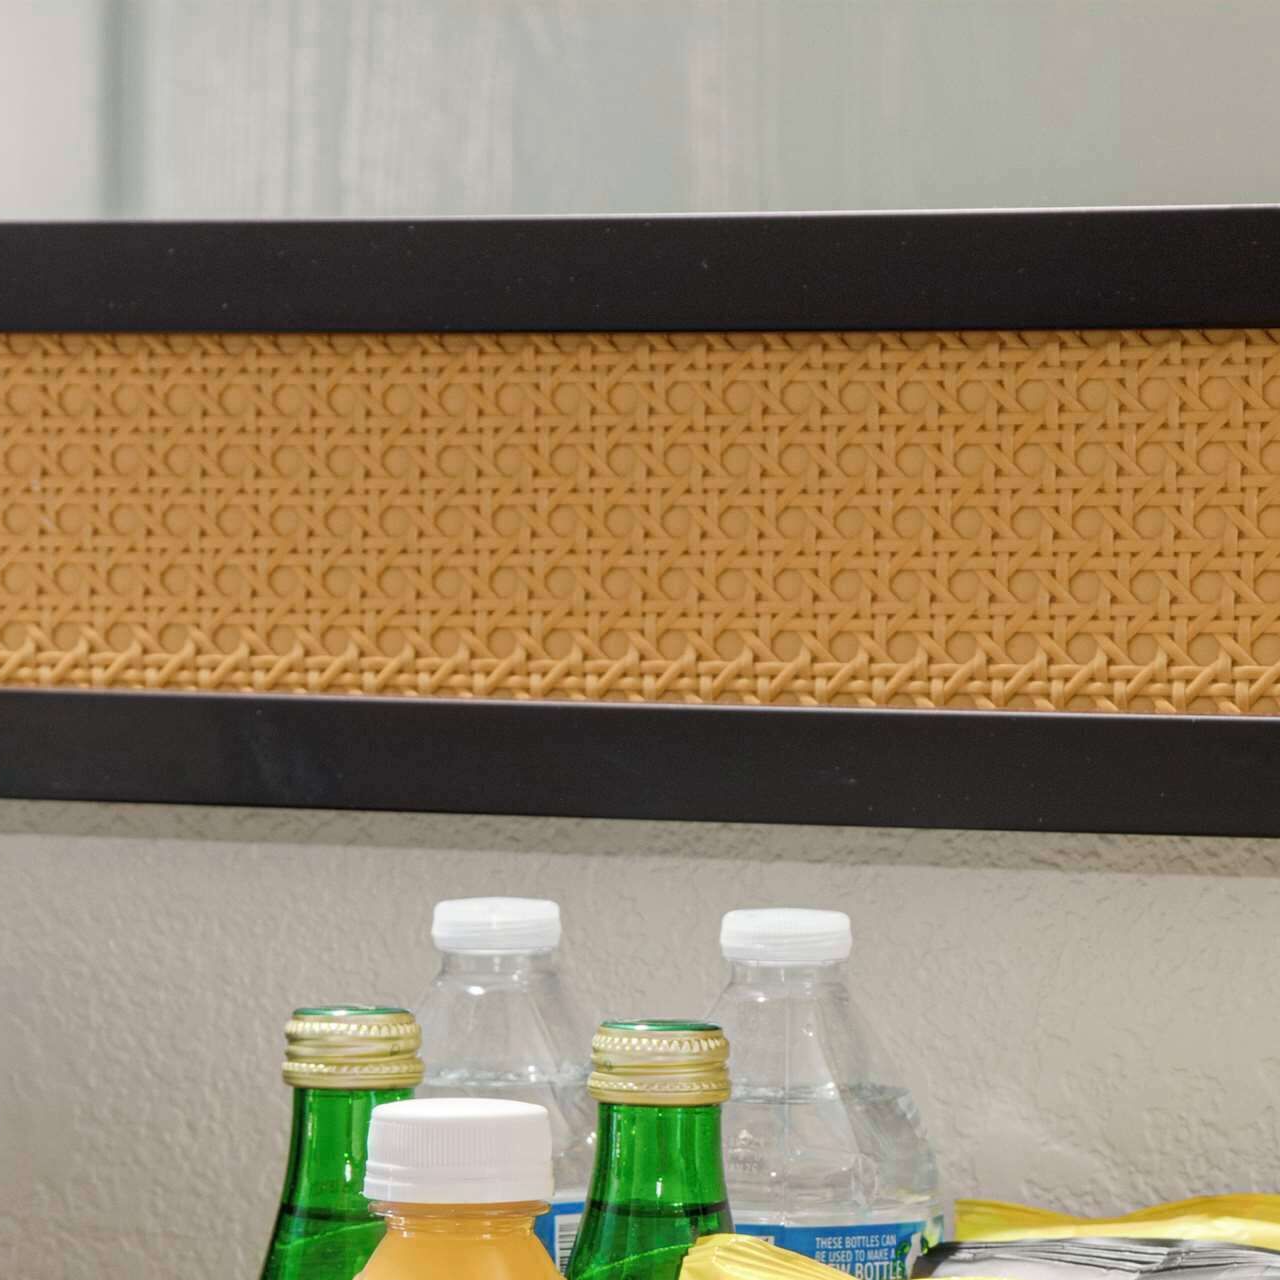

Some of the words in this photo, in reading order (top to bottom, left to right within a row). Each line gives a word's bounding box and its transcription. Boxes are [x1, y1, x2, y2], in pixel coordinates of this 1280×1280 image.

[816, 1236, 843, 1248] THESE
[845, 1235, 880, 1248] BOTTLES
[881, 1234, 896, 1246] CAN
[828, 1250, 853, 1262] USED
[854, 1249, 865, 1261] TO
[867, 1249, 889, 1260] MAKE
[891, 1248, 897, 1258] A
